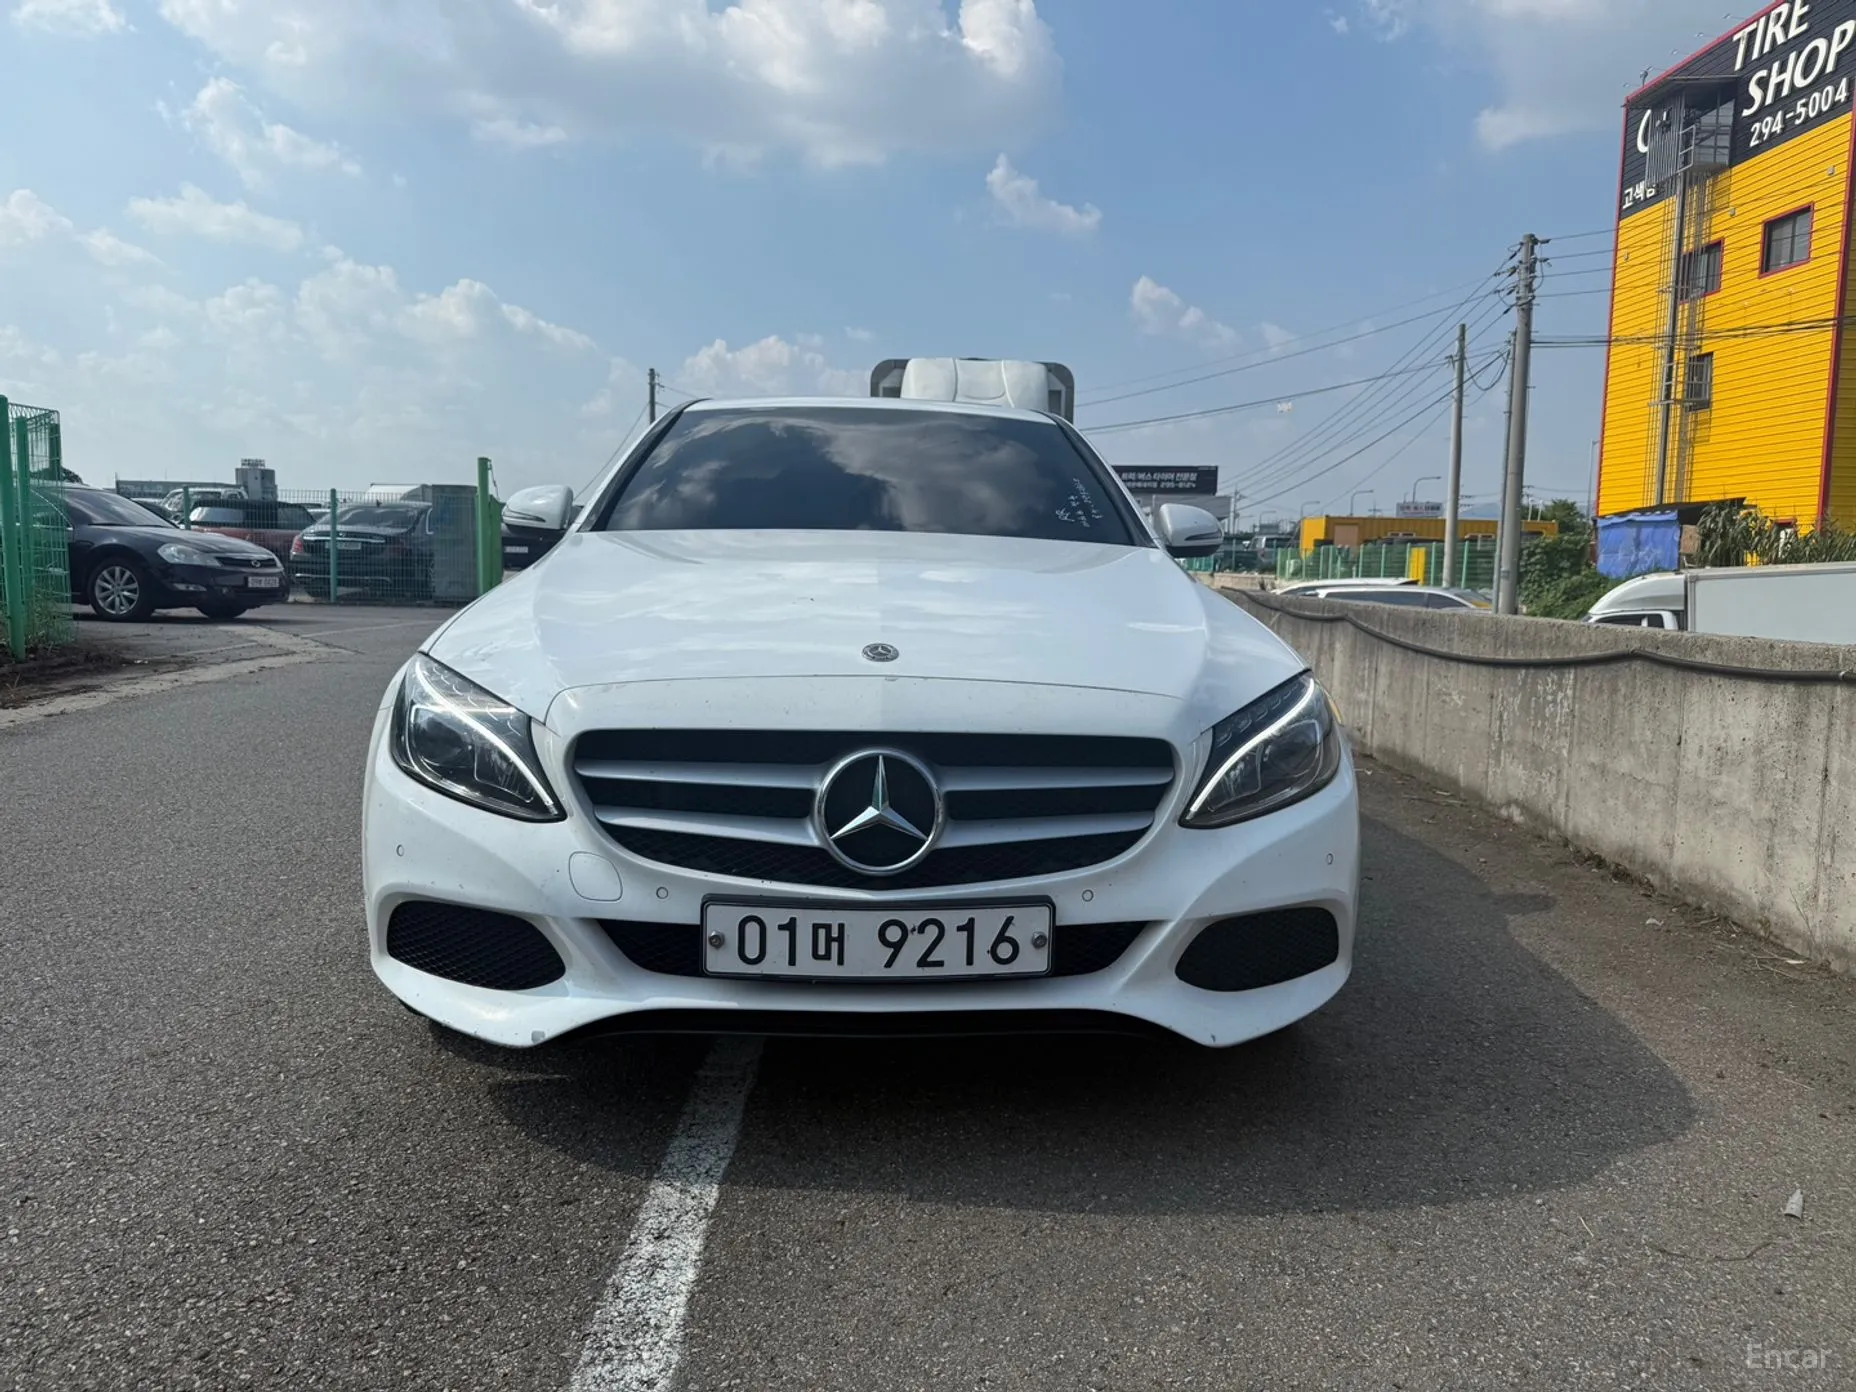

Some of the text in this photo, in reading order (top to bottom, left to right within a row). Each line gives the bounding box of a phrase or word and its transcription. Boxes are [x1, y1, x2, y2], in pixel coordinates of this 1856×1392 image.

[1732, 0, 1810, 71] TIRE
[1742, 20, 1856, 116] SHOP
[1749, 77, 1849, 147] 294-5004
[737, 914, 1021, 969] 01머 9216
